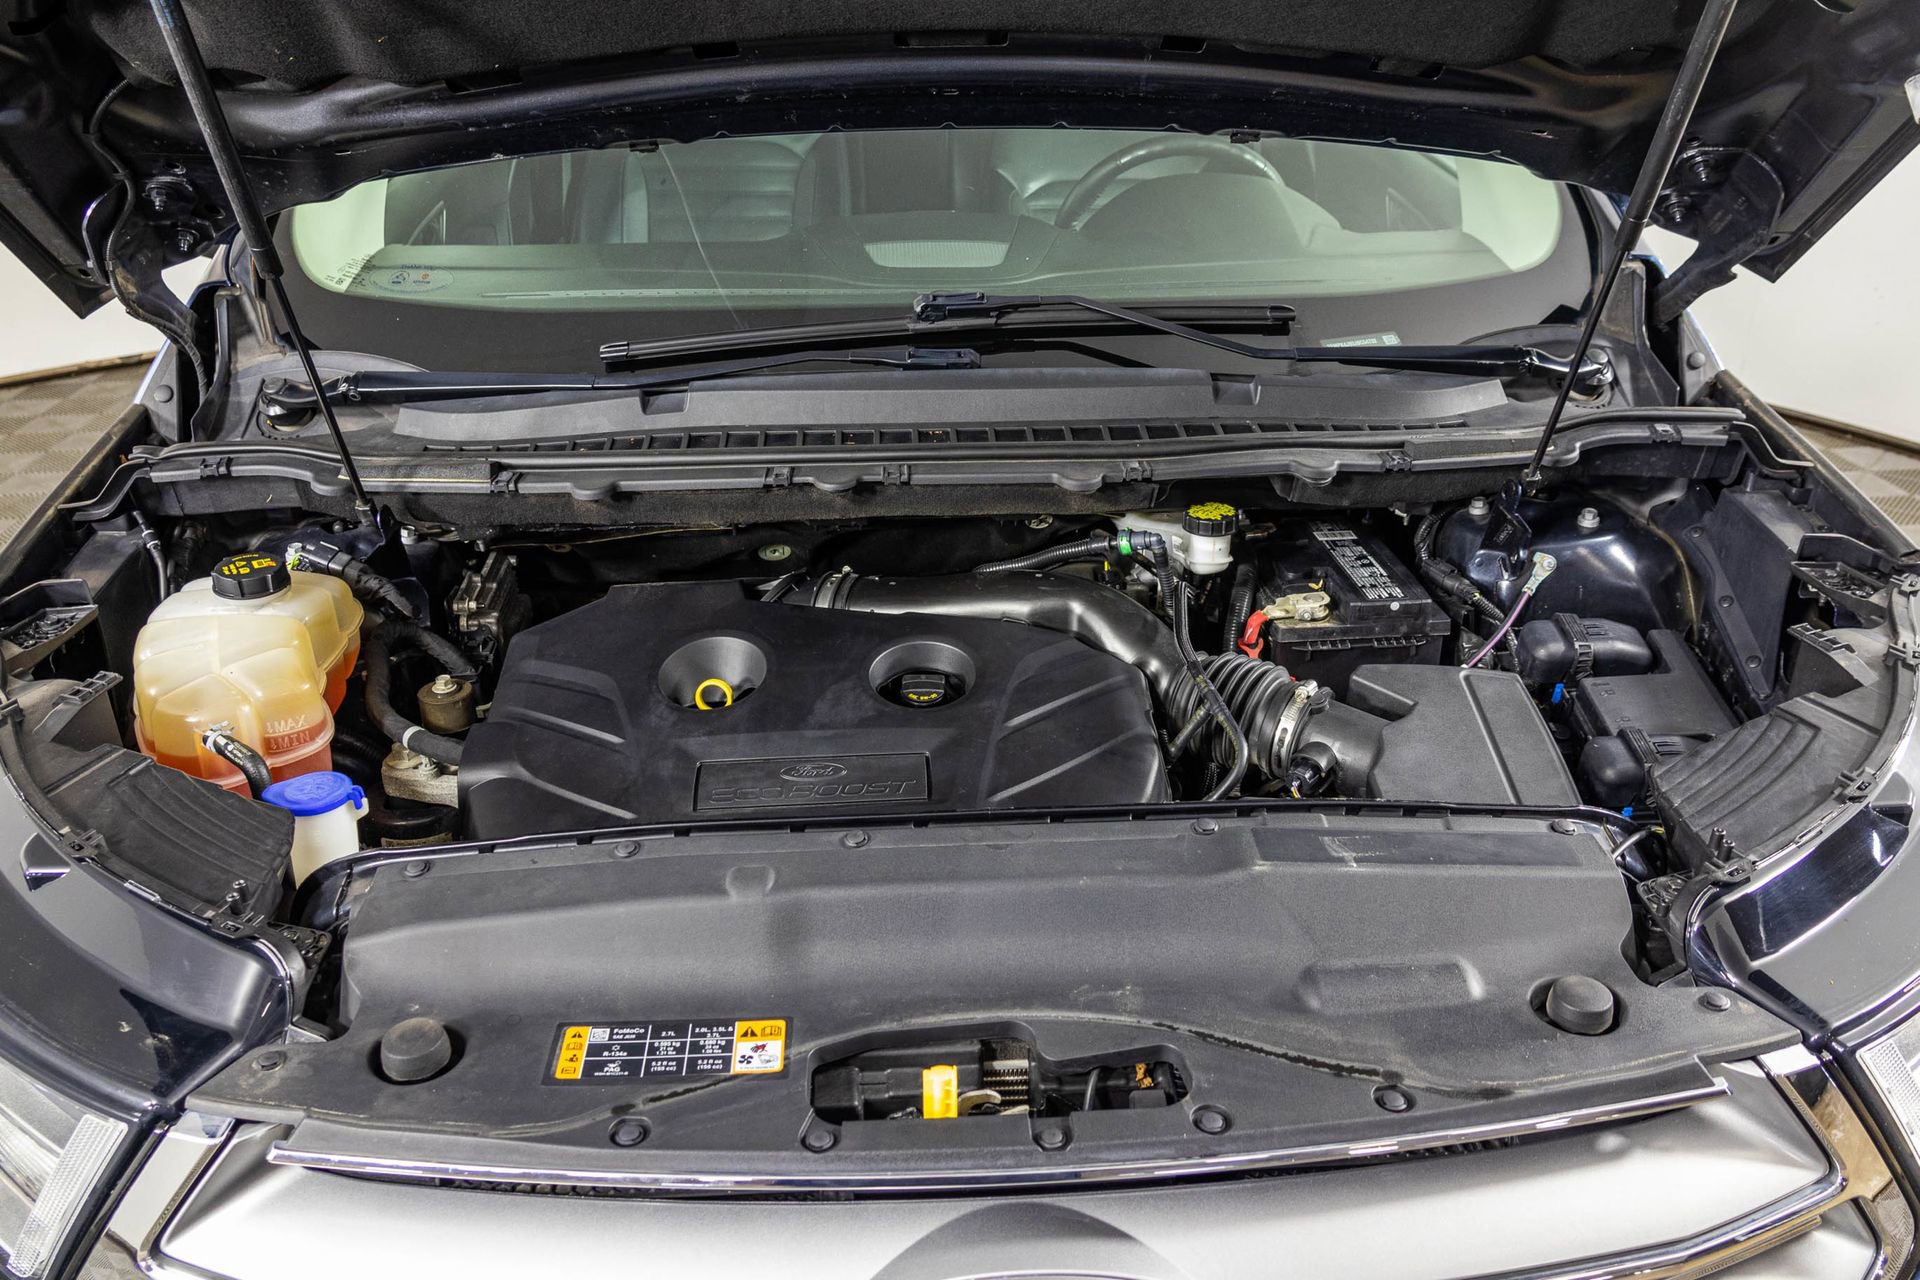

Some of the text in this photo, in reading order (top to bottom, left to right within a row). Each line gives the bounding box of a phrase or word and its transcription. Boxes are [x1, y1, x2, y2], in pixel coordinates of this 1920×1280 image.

[273, 714, 305, 733] MAX
[278, 730, 310, 749] MIN
[791, 764, 835, 777] Ford
[709, 780, 918, 804] ECOBOOST
